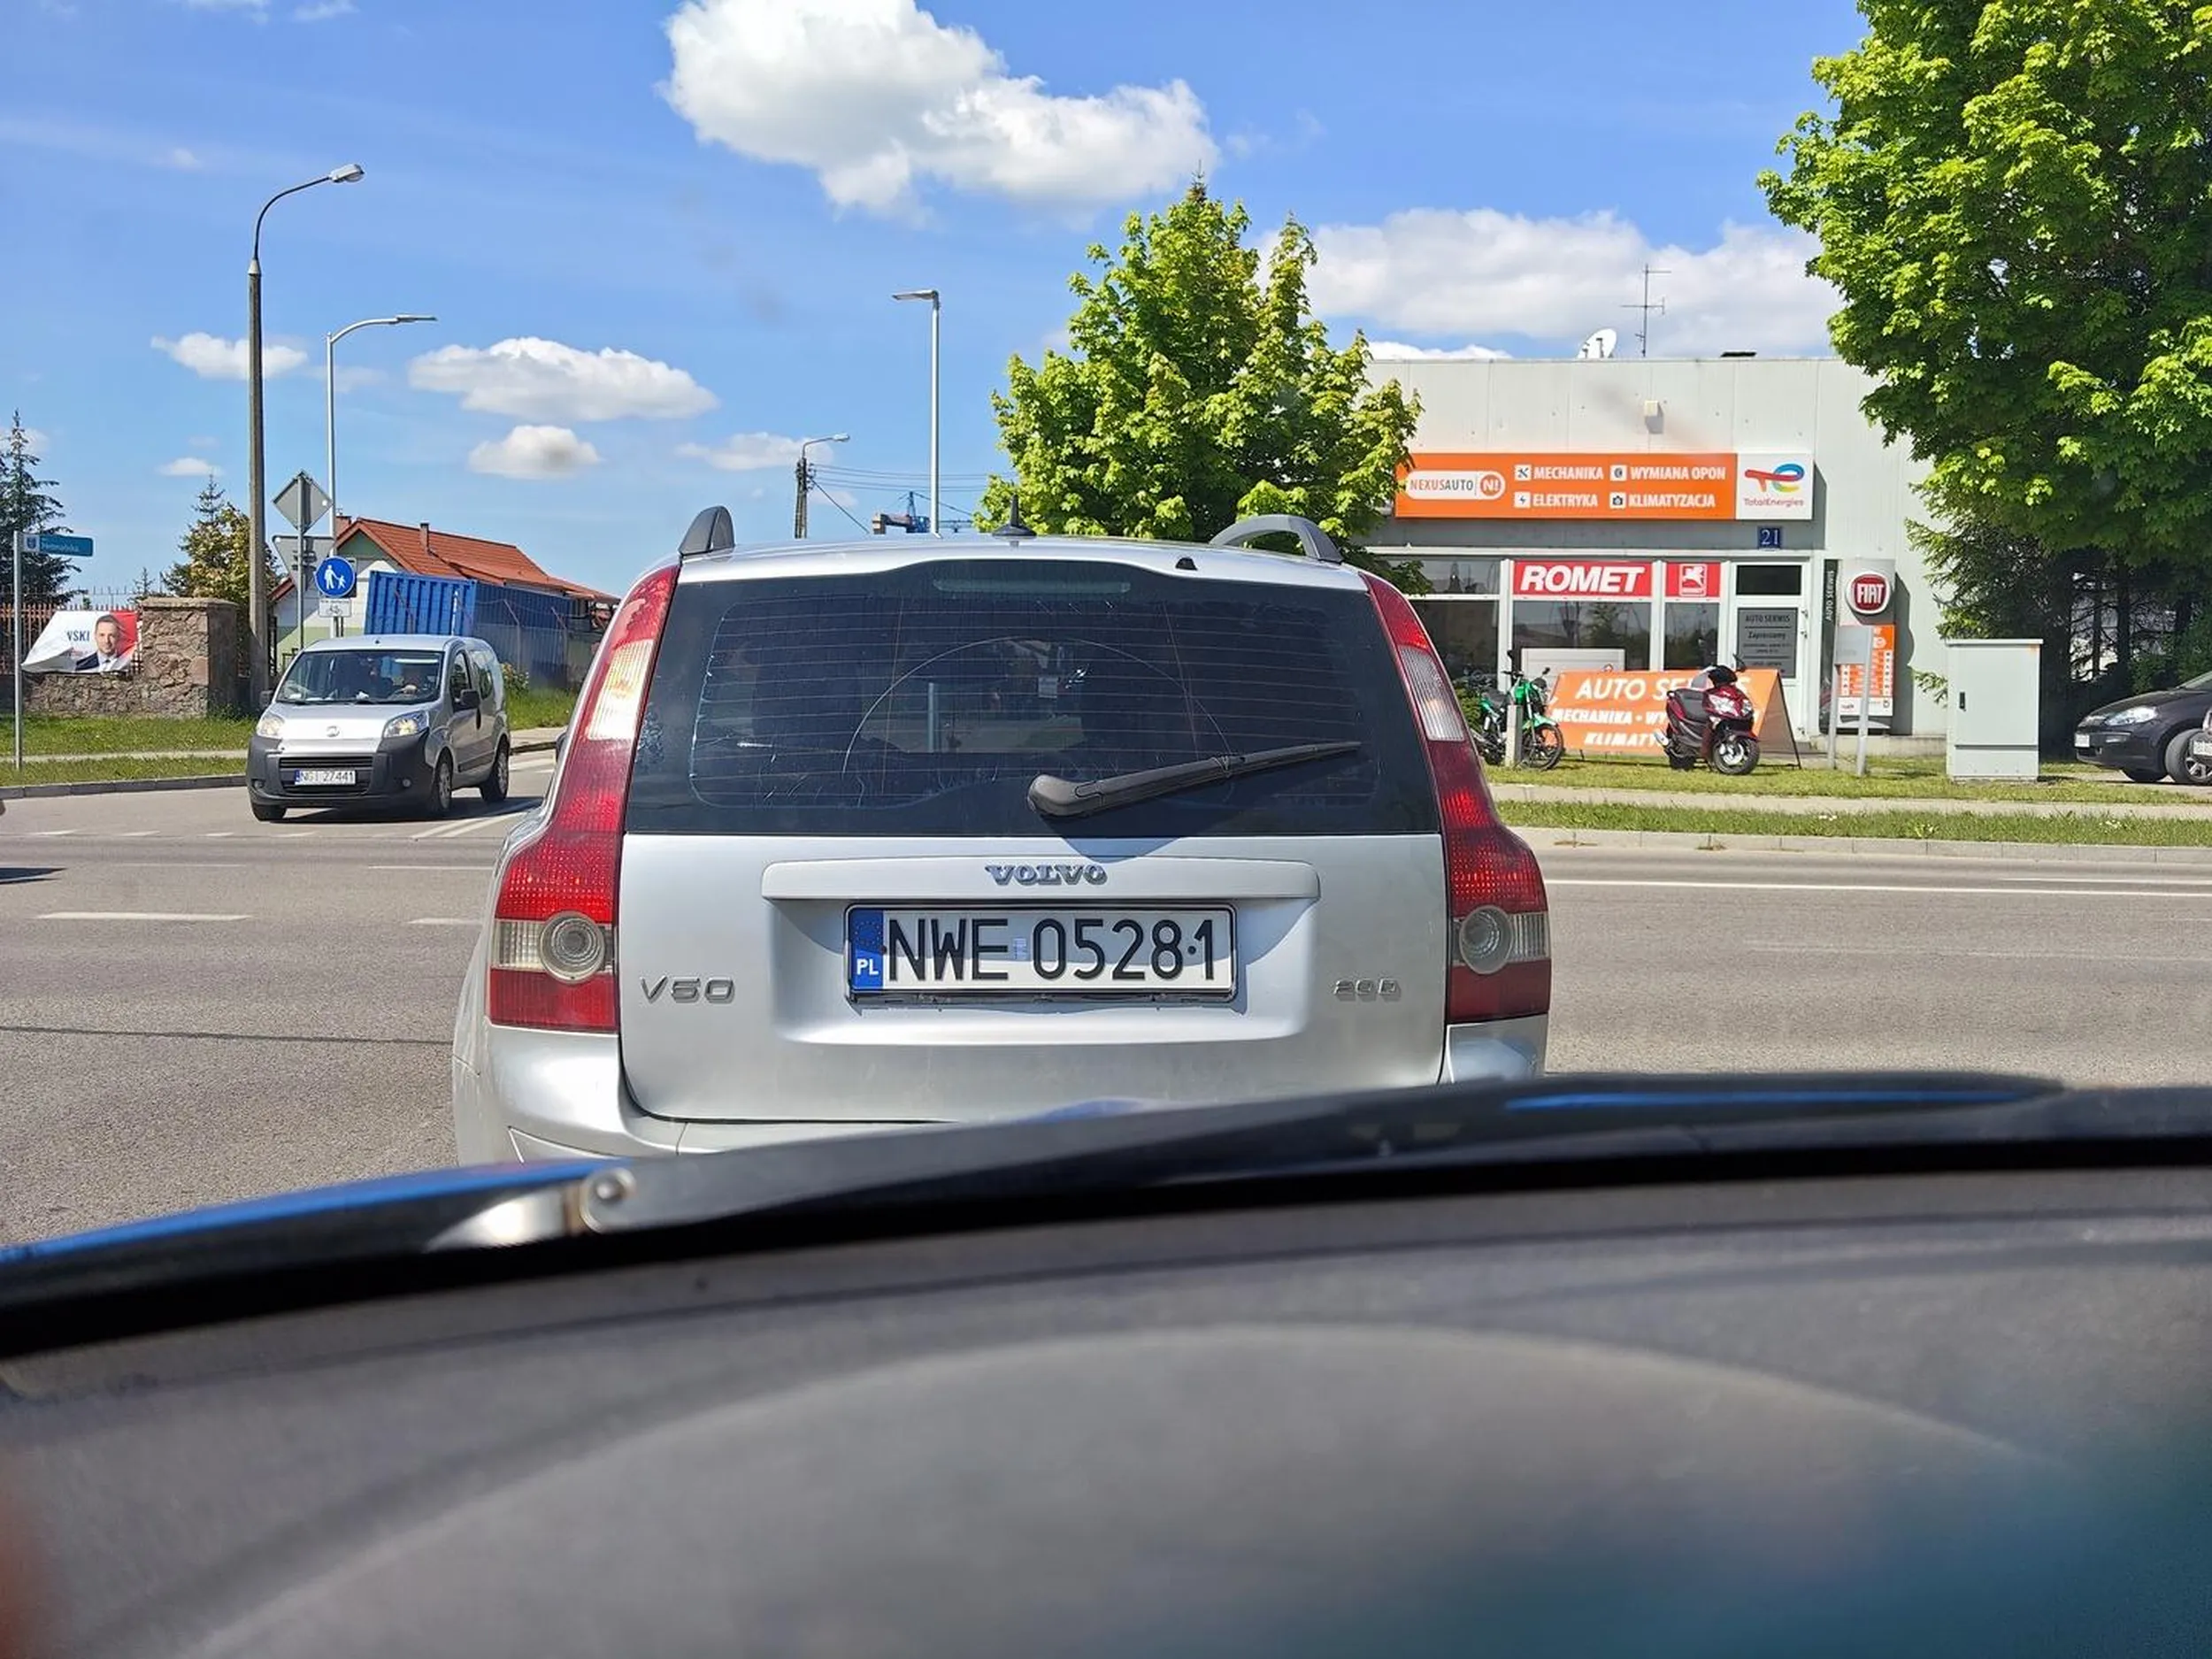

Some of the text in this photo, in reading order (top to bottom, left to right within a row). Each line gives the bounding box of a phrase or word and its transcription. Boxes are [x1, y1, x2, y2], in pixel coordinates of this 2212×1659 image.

[1533, 466, 1604, 480] MECHANIKA
[1631, 466, 1726, 480] WYMIANA OPON
[1410, 479, 1474, 491] NEXUSAUTO
[1532, 494, 1599, 508] ELEKTRYKA
[1628, 494, 1717, 508] KLIMATYZACJA
[1744, 497, 1805, 507] TotalEnergies
[1761, 529, 1779, 546] 21
[1520, 565, 1645, 593] ROMET
[1857, 582, 1885, 603] FIAT
[1576, 678, 1645, 700] AUTO
[1550, 708, 1632, 725] MECHANIKA
[985, 864, 1108, 885] VOLVO
[888, 918, 1214, 980] NWE 05281
[856, 959, 879, 976] PL
[640, 975, 735, 1004] V50
